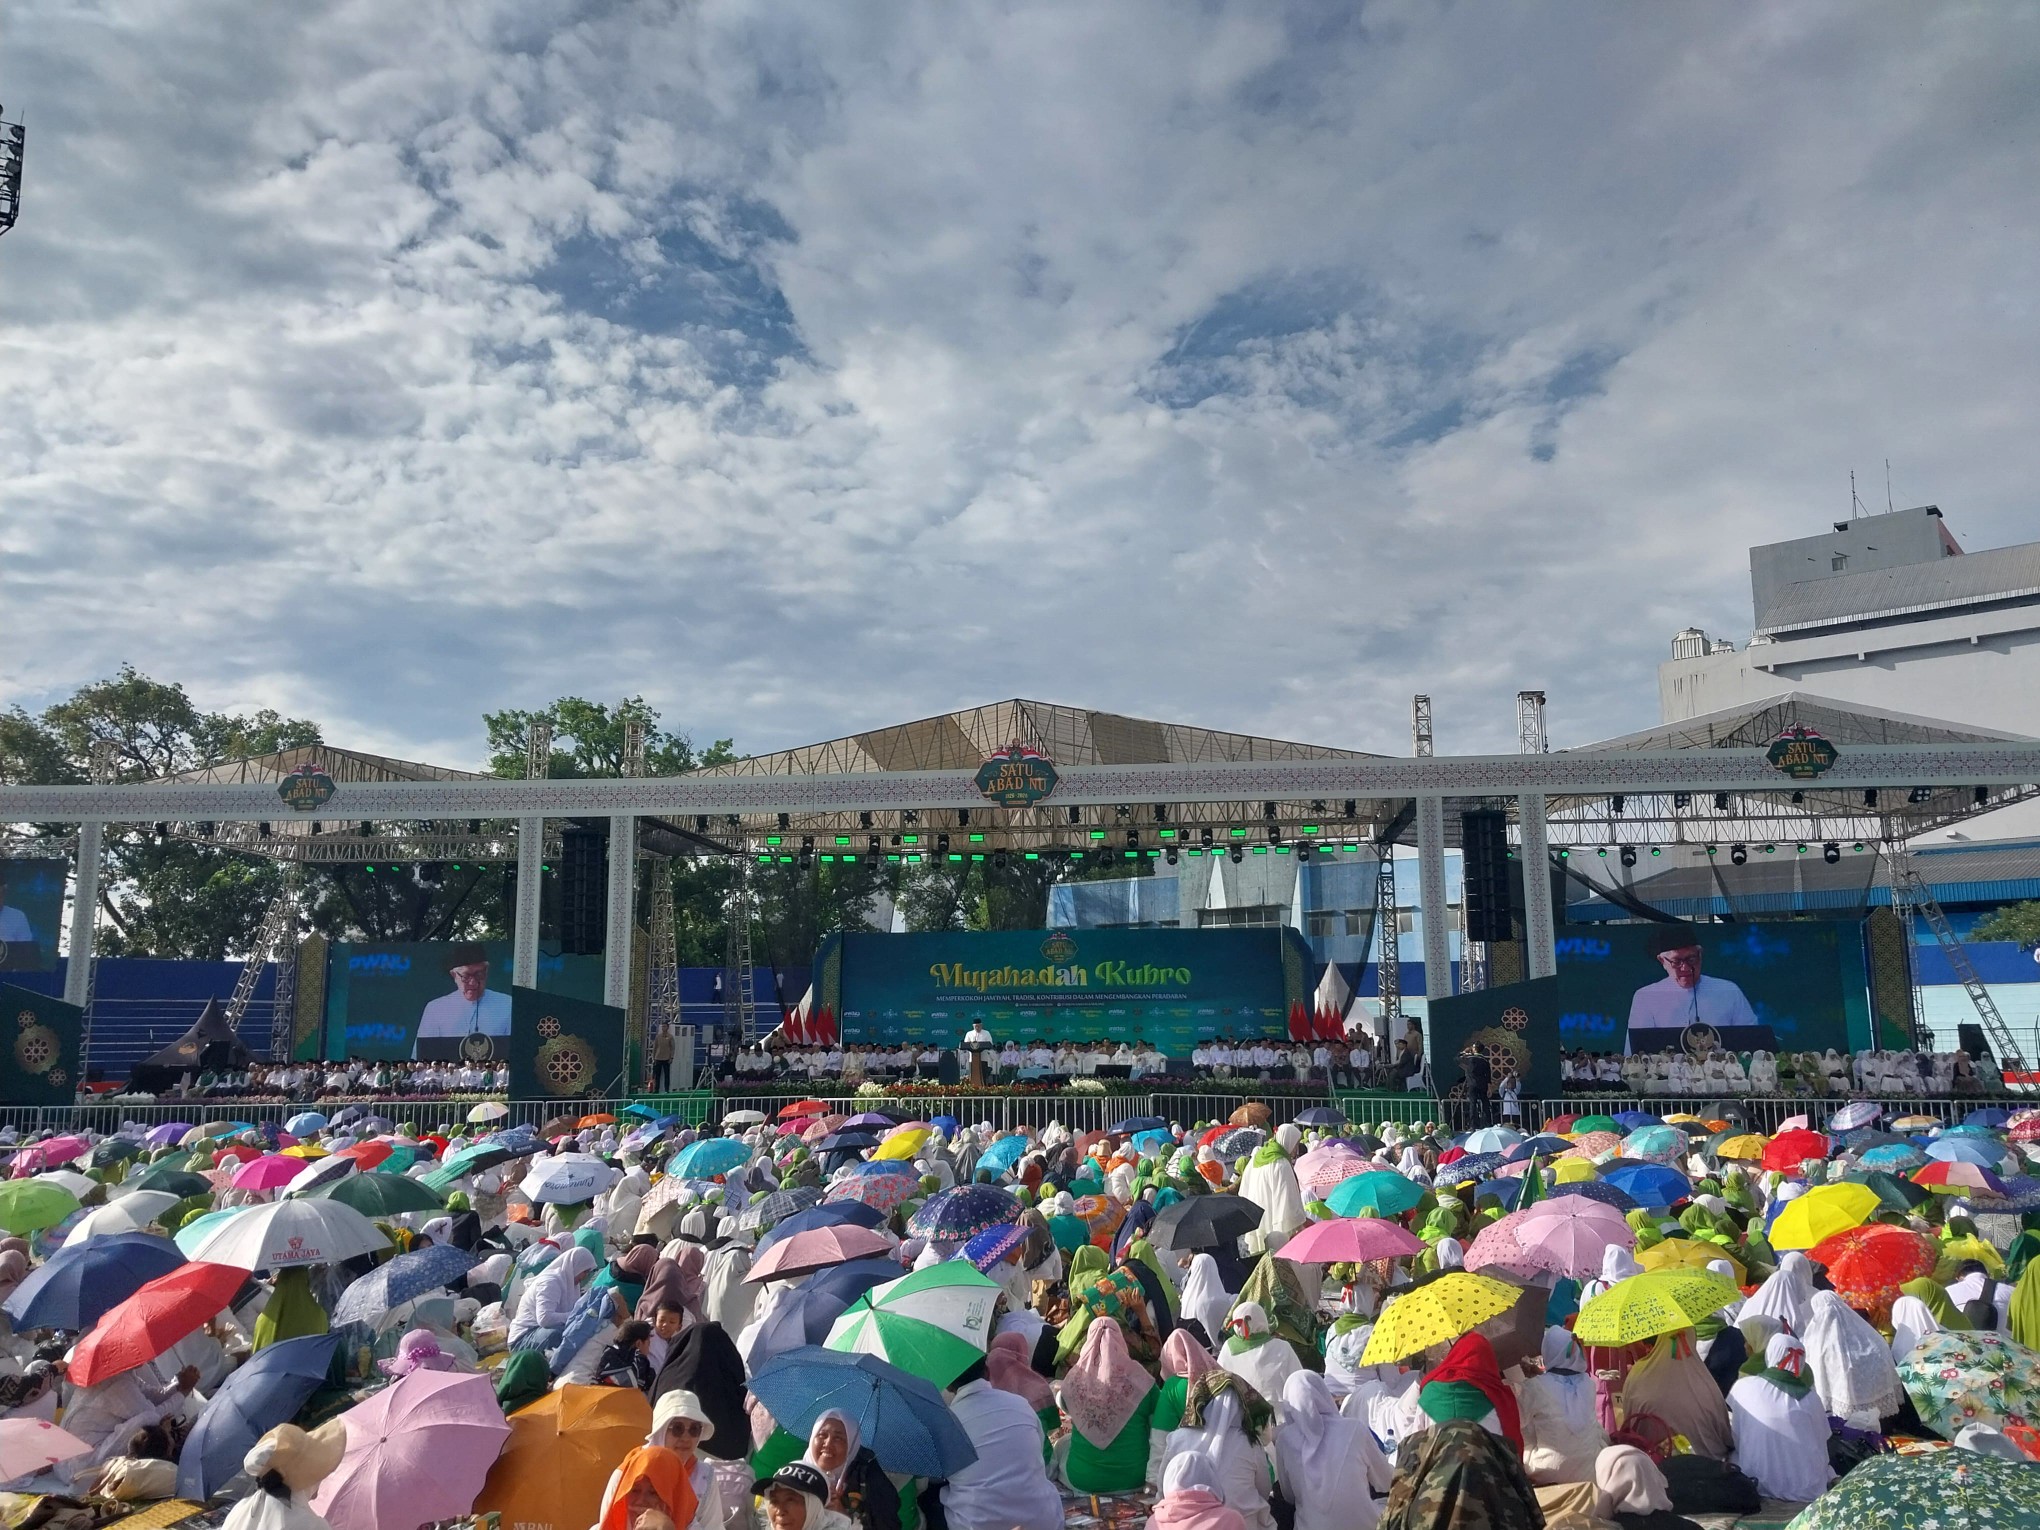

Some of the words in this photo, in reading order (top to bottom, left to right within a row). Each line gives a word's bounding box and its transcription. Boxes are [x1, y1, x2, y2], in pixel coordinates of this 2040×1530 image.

[1787, 742, 1816, 754] SATU
[1778, 753, 1809, 767] ABAD
[1813, 754, 1829, 765] NU
[999, 763, 1034, 777] SATU
[985, 777, 1024, 793] ABAD
[1029, 778, 1047, 791] NU
[930, 963, 1088, 992] Mujahadah
[1095, 960, 1192, 986] Kubro
[272, 1251, 300, 1260] UTAMA
[301, 1249, 321, 1258] JAYA
